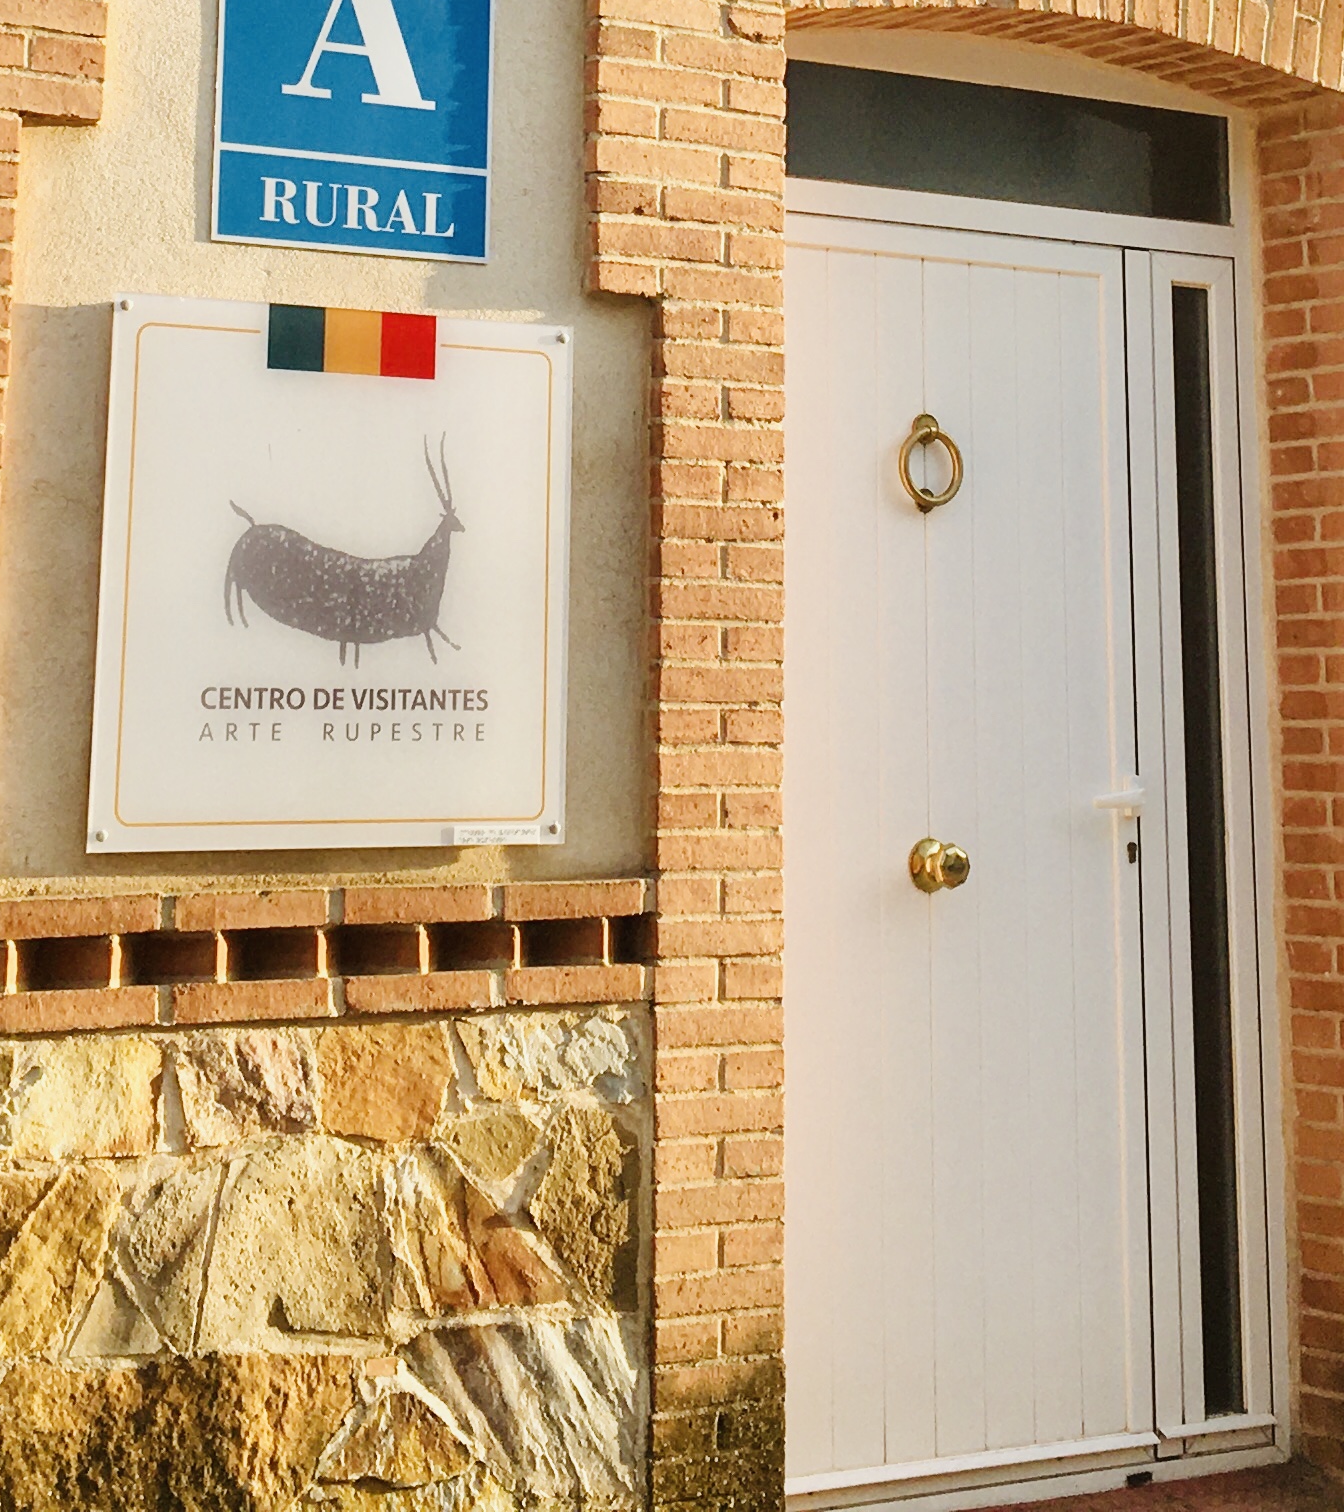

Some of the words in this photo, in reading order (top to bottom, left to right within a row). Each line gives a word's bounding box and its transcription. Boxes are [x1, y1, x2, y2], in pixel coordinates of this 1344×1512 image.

[259, 176, 455, 238] RURAL
[200, 686, 306, 711] CENTRO
[313, 687, 345, 711] DE
[351, 688, 489, 712] VISITANTES
[198, 722, 282, 741] ARTE
[323, 722, 485, 742] RUPESTRE
